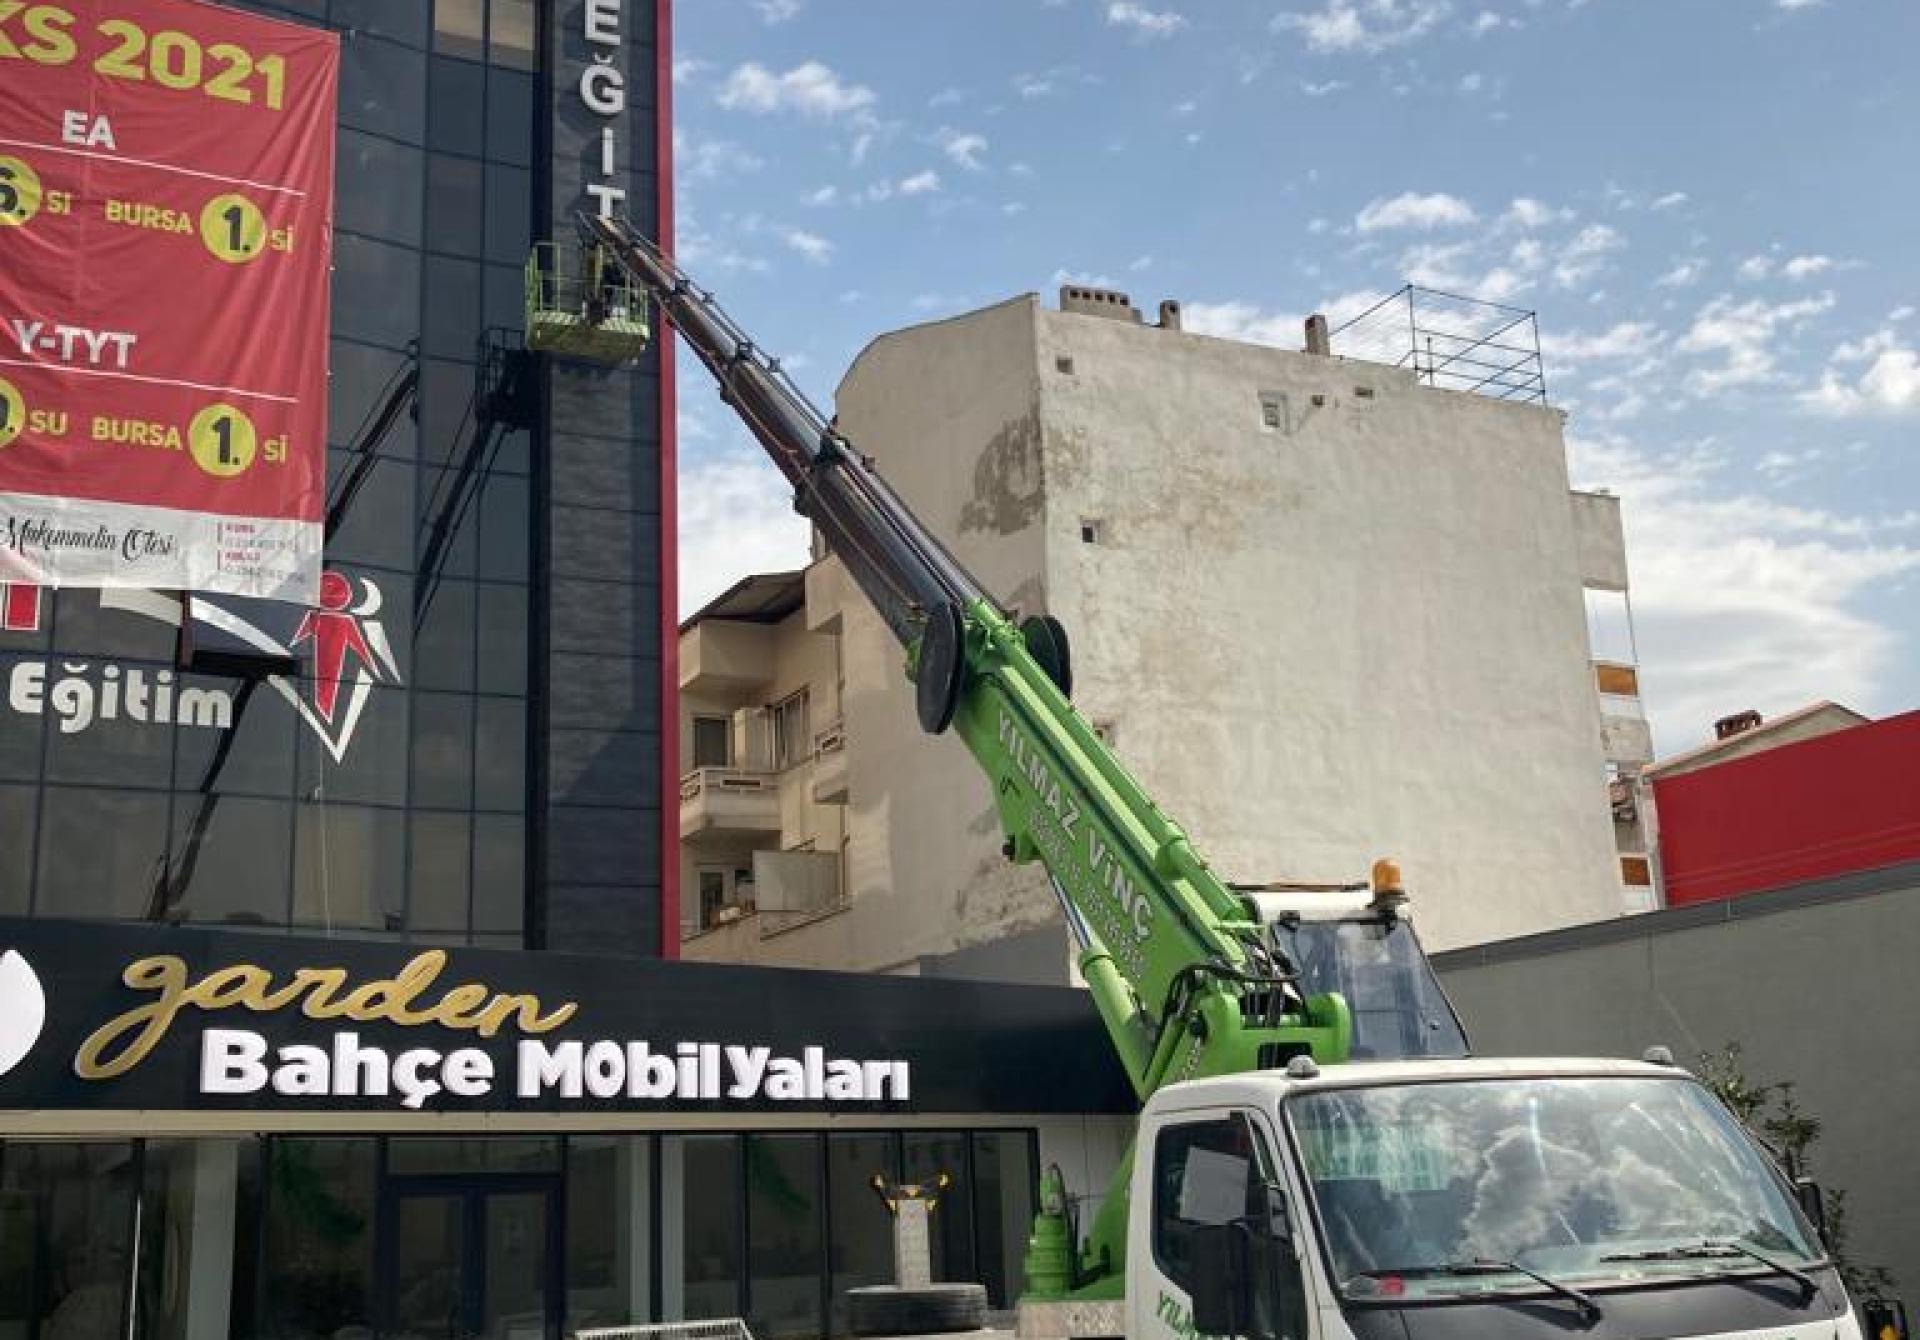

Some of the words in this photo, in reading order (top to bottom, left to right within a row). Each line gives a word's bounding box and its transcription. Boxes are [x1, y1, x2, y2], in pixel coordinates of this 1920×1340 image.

[94, 19, 284, 110] 2021
[62, 110, 116, 150] EA
[105, 199, 194, 235] BURSA
[223, 205, 251, 252] 1.
[29, 410, 68, 435] SU
[92, 416, 183, 450] BURSA
[211, 415, 240, 465] 1.
[9, 661, 234, 734] Eğitim
[1000, 709, 1081, 842] YILMAZ
[74, 949, 579, 1080] garden
[201, 1029, 496, 1109] Bahçe
